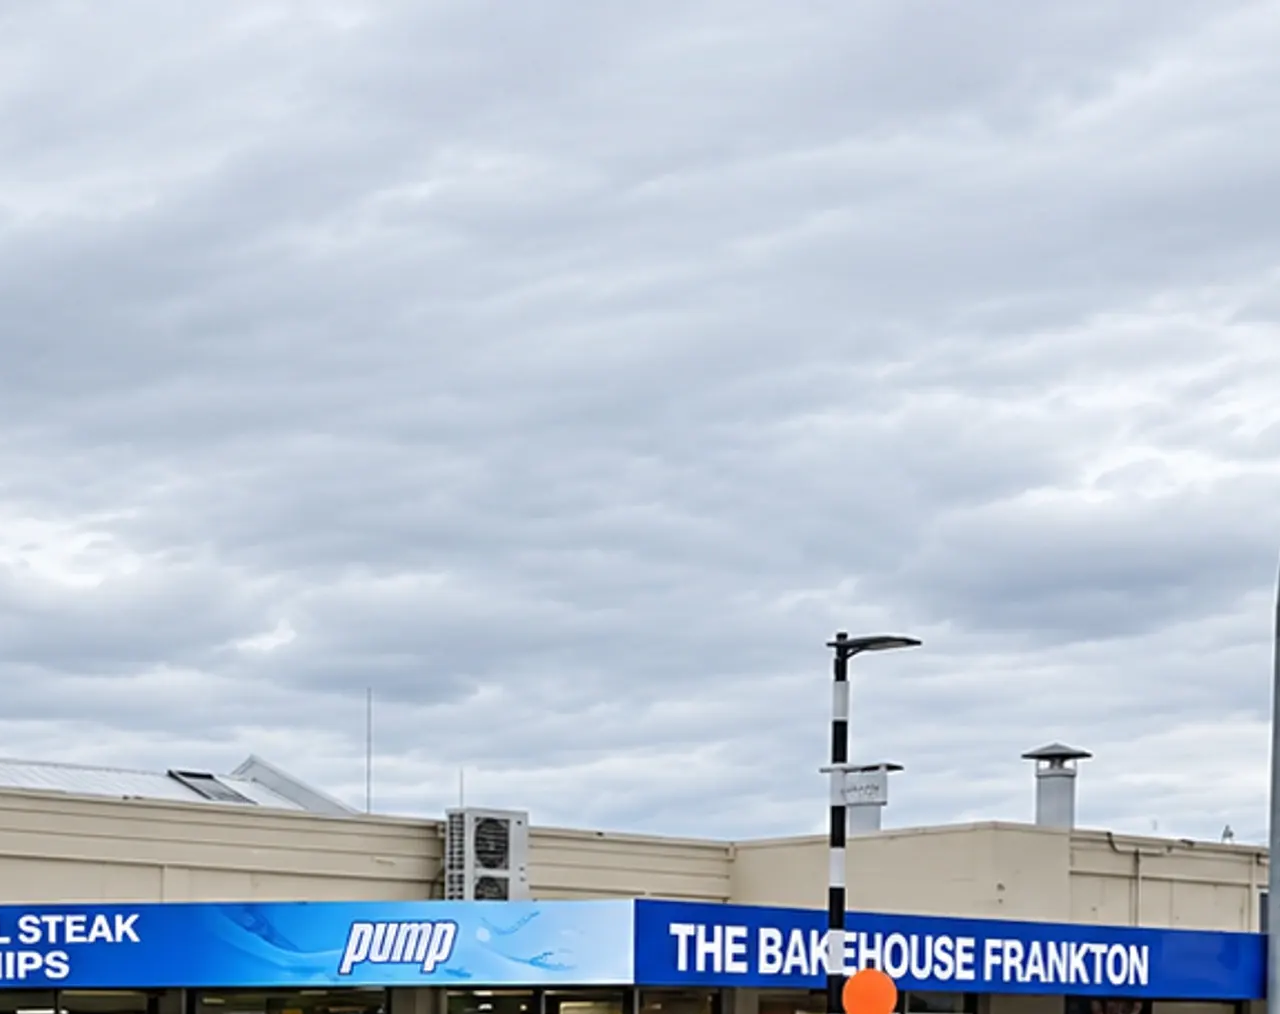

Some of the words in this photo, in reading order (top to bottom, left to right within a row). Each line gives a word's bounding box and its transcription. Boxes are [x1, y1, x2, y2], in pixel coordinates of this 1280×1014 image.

[18, 914, 140, 943] STEAK
[339, 921, 457, 974] pump
[669, 922, 748, 973] THE
[758, 927, 976, 980] BAKEHOUSE
[984, 938, 1150, 985] FRANKTON
